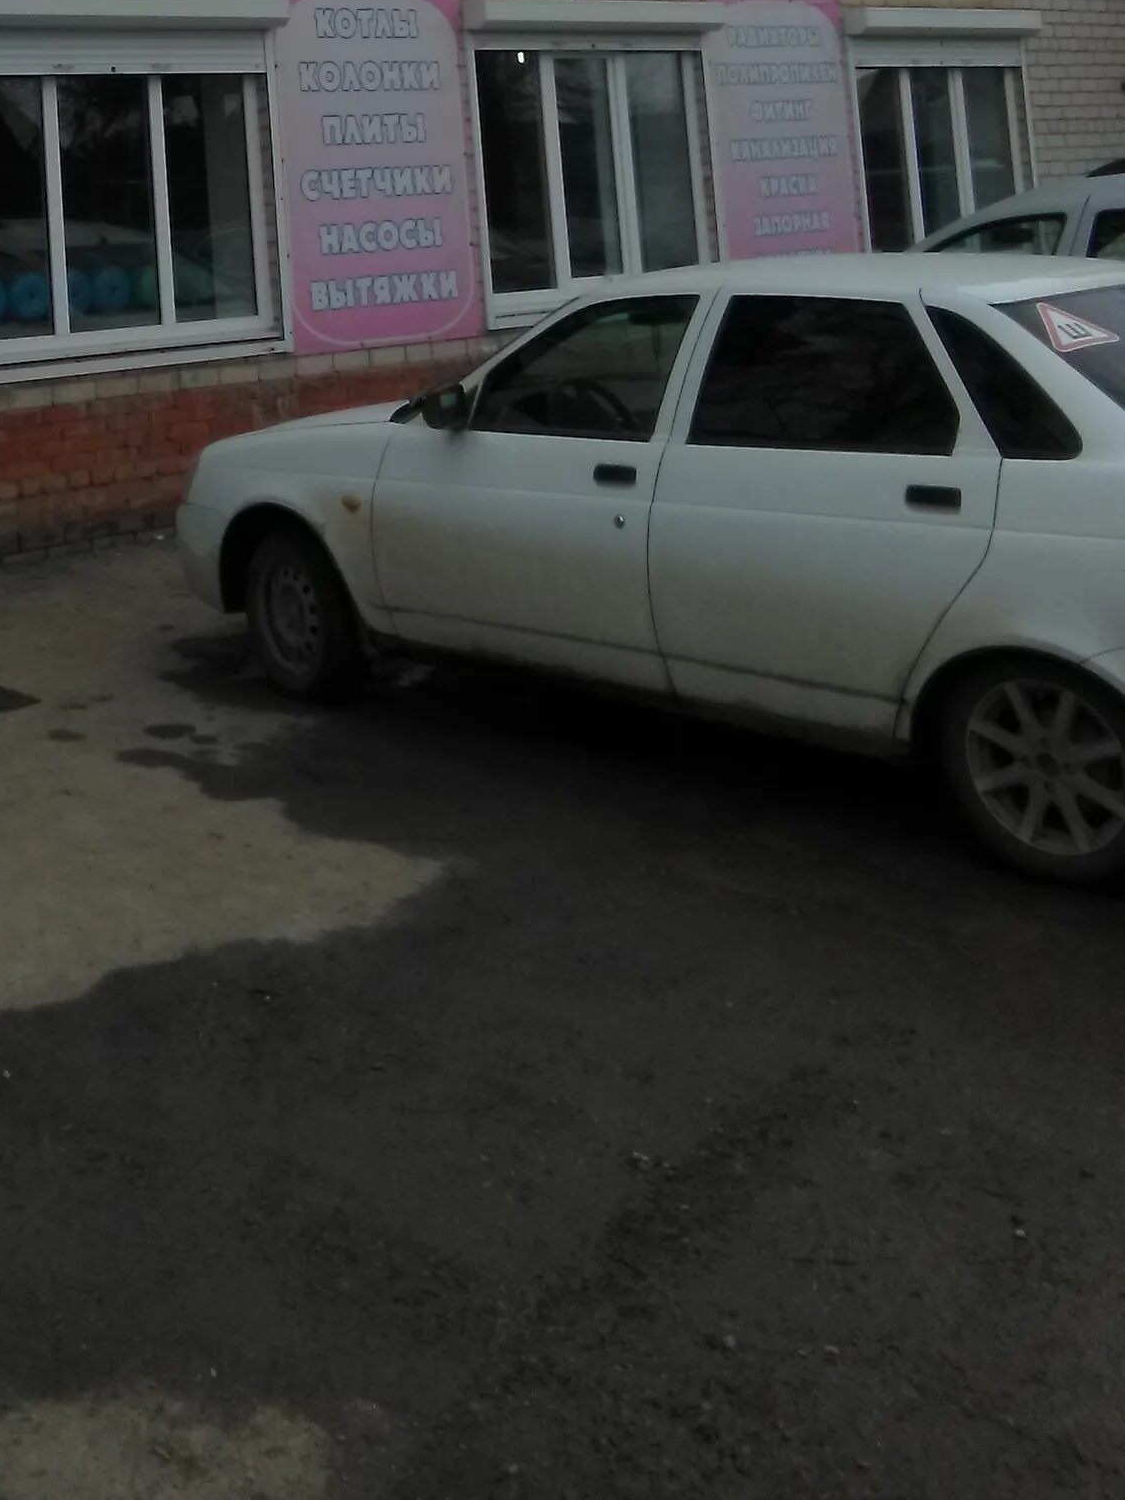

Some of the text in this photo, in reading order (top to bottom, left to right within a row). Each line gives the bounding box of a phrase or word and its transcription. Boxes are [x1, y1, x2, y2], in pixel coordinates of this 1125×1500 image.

[314, 8, 418, 39] КОТЛЫ
[728, 25, 821, 48] РАДИАТОРЫ
[298, 61, 440, 92] КОЛОНКИ
[717, 63, 838, 86] ПОЛИПРОПИЛЕН
[749, 100, 813, 122] ФИТИНГ
[321, 113, 426, 145] ПЛИТЫ
[730, 136, 838, 162] КАНАЛИЗАЦИЯ
[301, 165, 452, 201] СЧЕТЧИКИ
[760, 175, 818, 197] КРАСКА
[320, 218, 443, 255] НАСОСЫ
[754, 212, 831, 237] ЗАПОРНАЯ
[310, 270, 458, 311] ВЫТЯЖКИ
[1057, 322, 1092, 339] Ш
